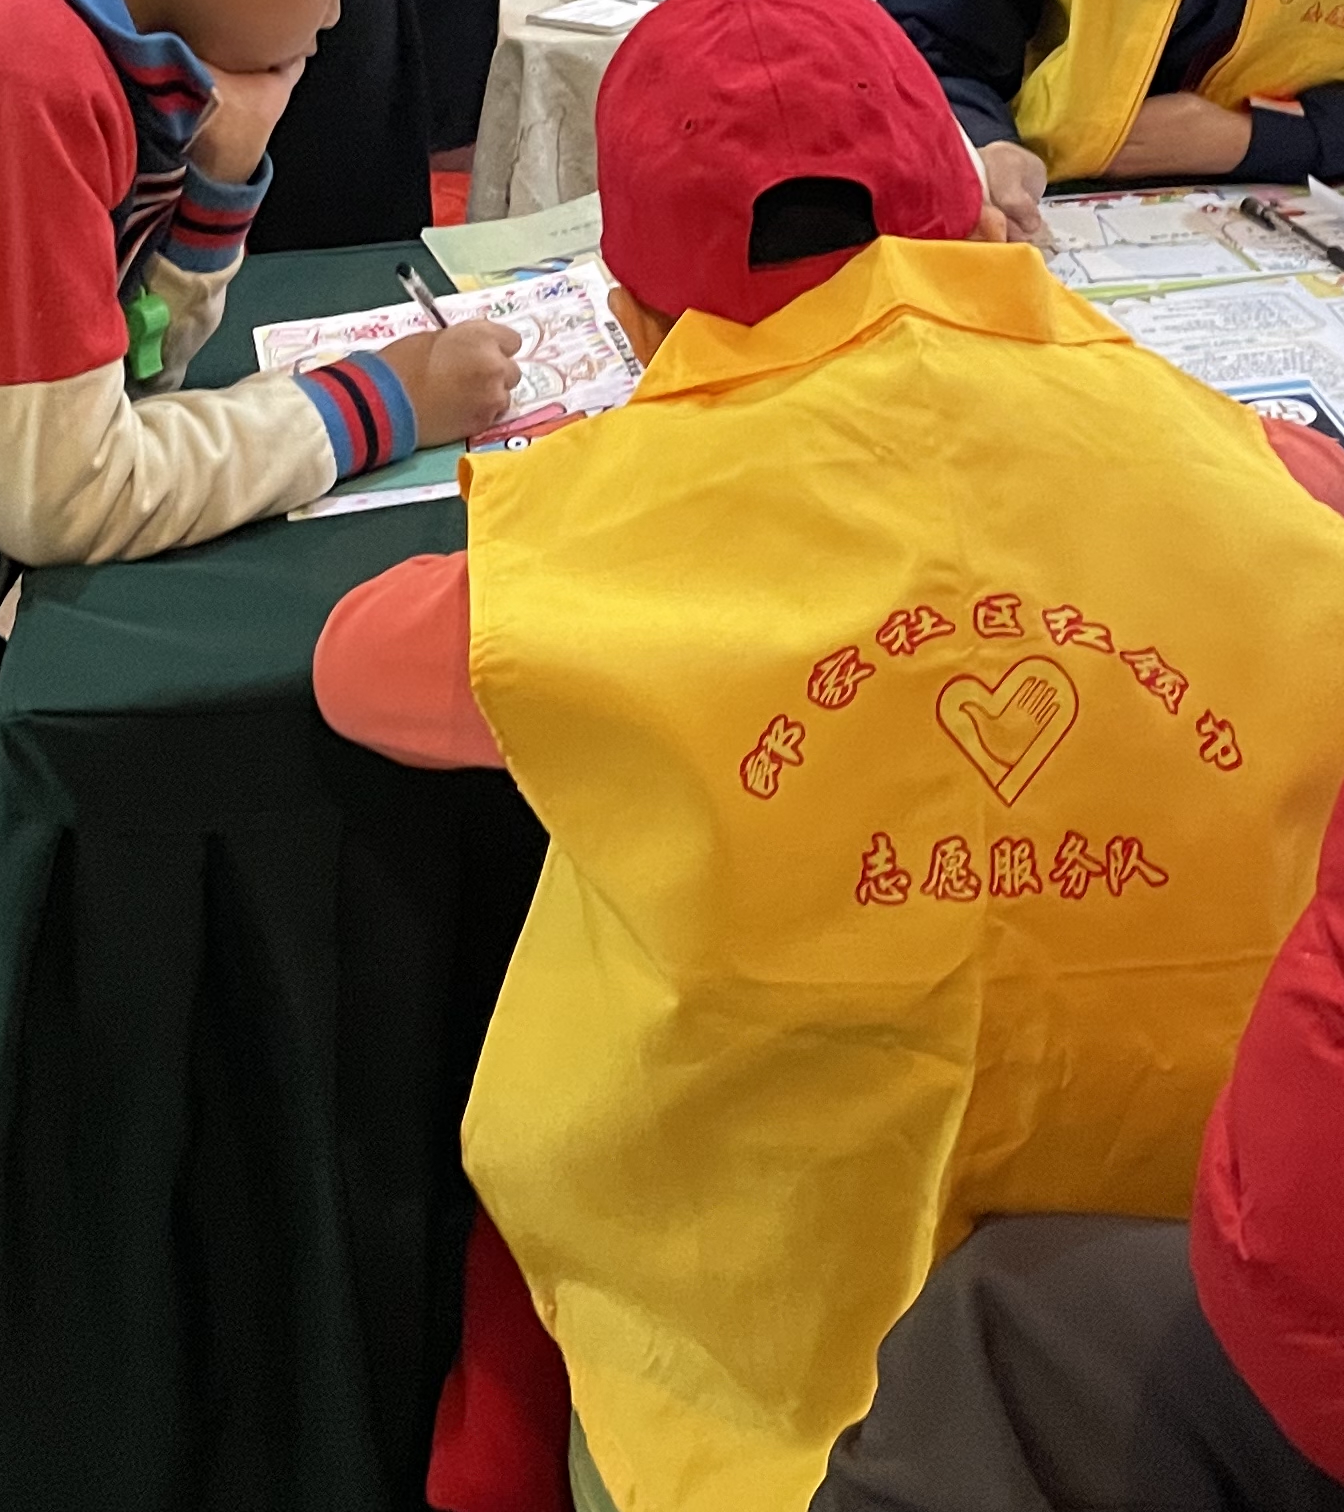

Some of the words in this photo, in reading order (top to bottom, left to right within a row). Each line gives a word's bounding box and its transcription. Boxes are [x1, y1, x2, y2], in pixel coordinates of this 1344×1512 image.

[856, 830, 1168, 905] 志愿服务队
